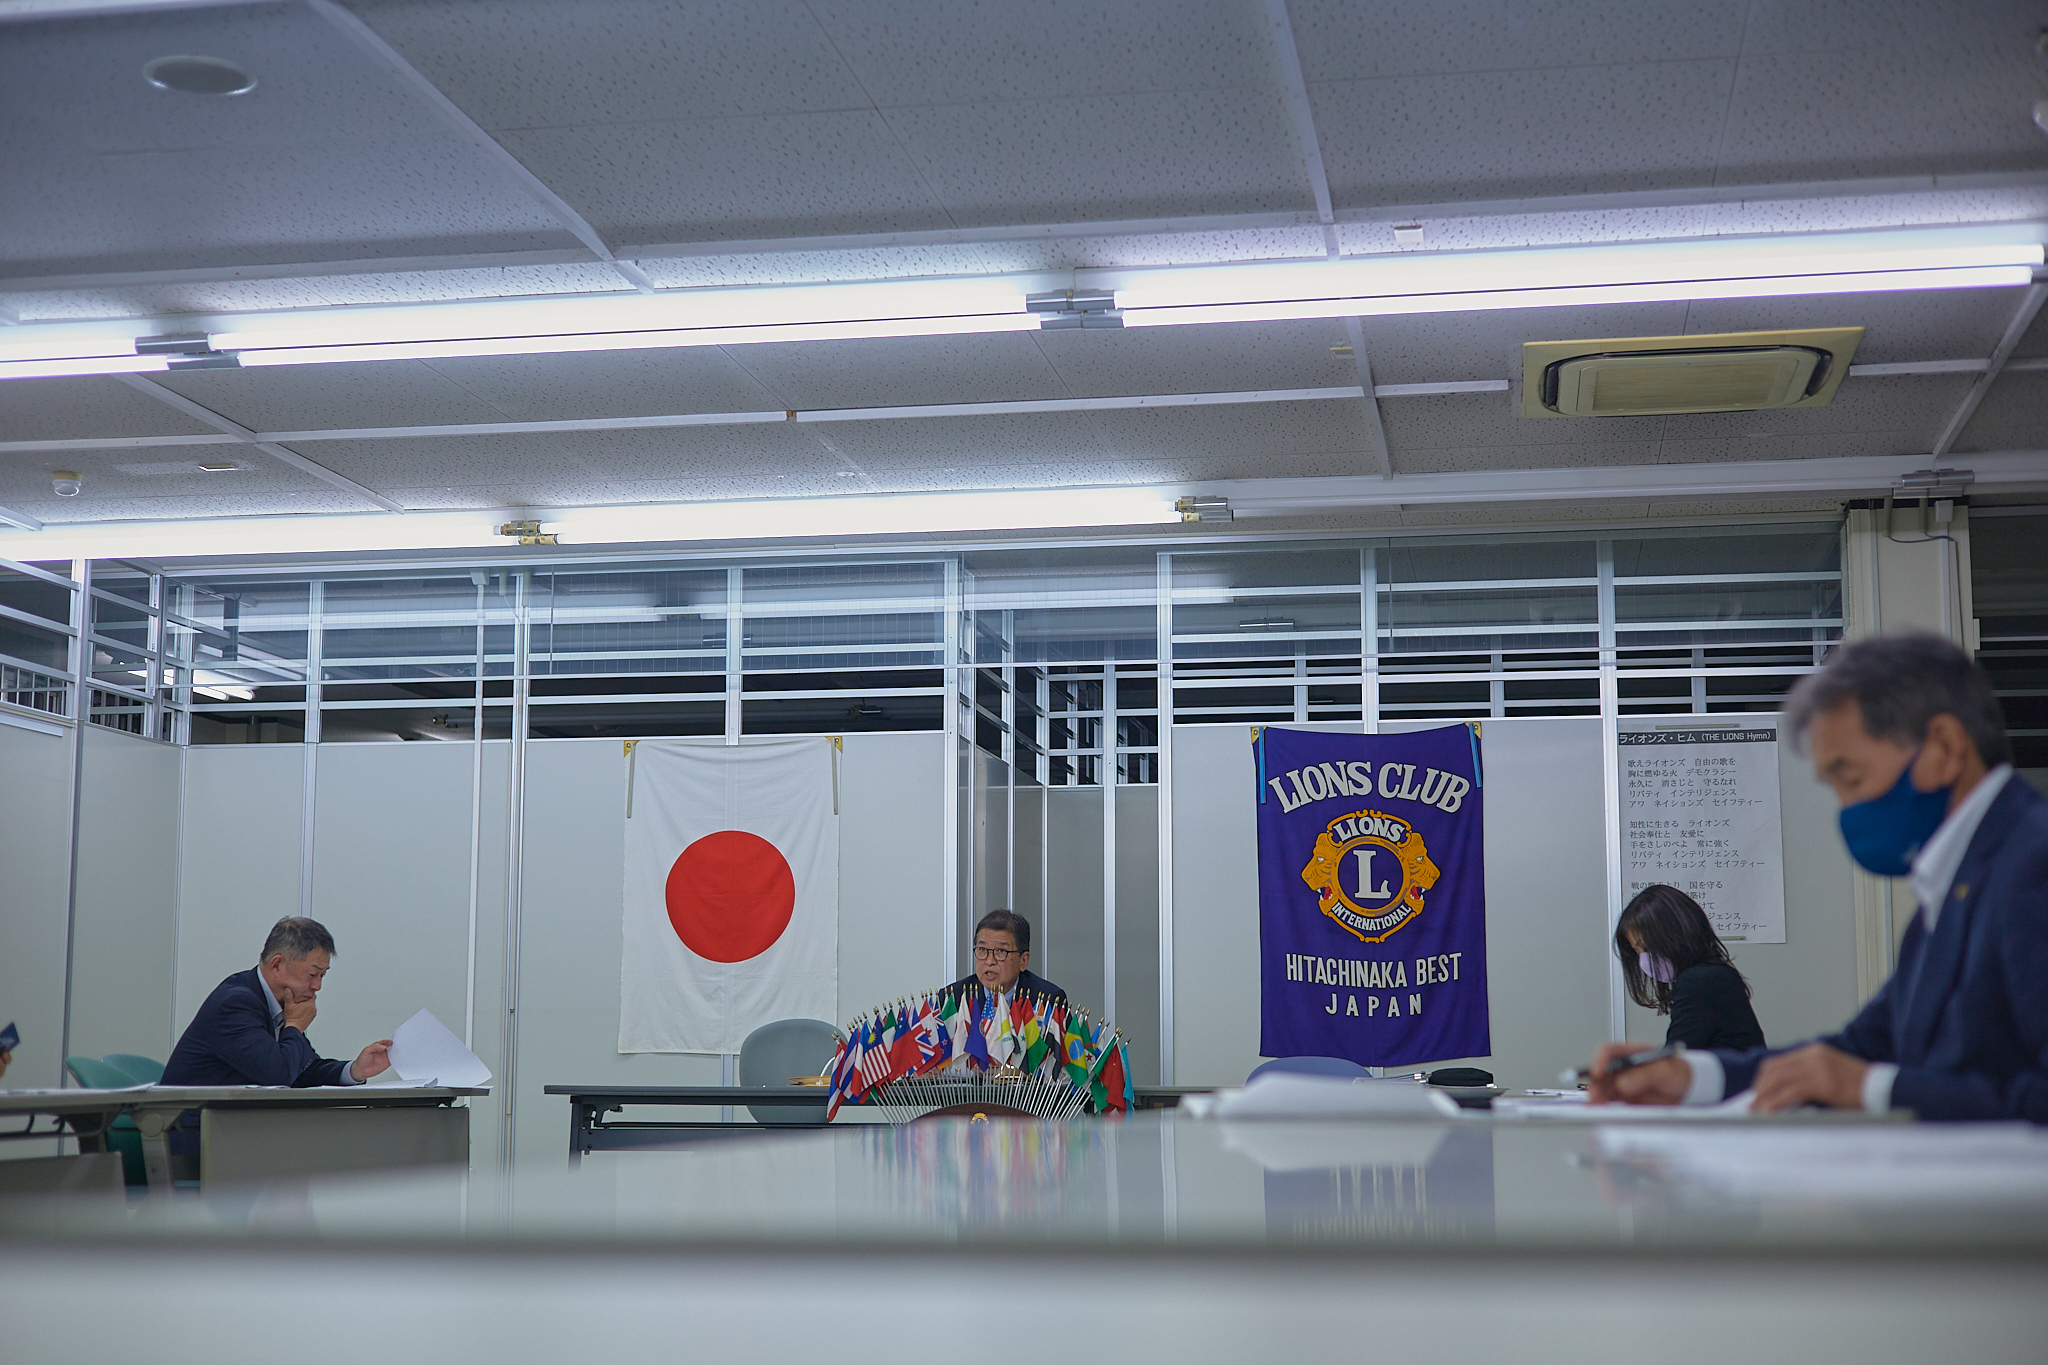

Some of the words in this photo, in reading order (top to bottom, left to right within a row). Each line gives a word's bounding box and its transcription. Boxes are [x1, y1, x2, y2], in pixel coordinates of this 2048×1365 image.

[1619, 733, 1696, 744] ライオンズ・ヒム
[1628, 759, 1685, 768] 歌えライオンズ
[1694, 758, 1736, 766] 自由の歌を
[1268, 761, 1372, 814] LIONS
[1378, 762, 1470, 814] CLUB
[1628, 780, 1652, 788] 永久に
[1670, 788, 1737, 798] インテリジェンス
[1629, 800, 1645, 808] アワ
[1630, 820, 1679, 828] 知性に生きる
[1688, 819, 1730, 827] ライオンズ
[1333, 816, 1406, 843] LIONS
[1630, 831, 1670, 839] 社会奉仕と
[1697, 840, 1729, 848] 常に強く
[1672, 850, 1739, 858] インテリジェンス
[1353, 850, 1391, 898] L
[1689, 881, 1723, 889] 国を守る
[1331, 902, 1412, 931] INTERNATIONAL
[1286, 953, 1408, 989] HITACHINAKA
[1416, 952, 1462, 986] BEST
[1325, 993, 1422, 1018] JAPAN
